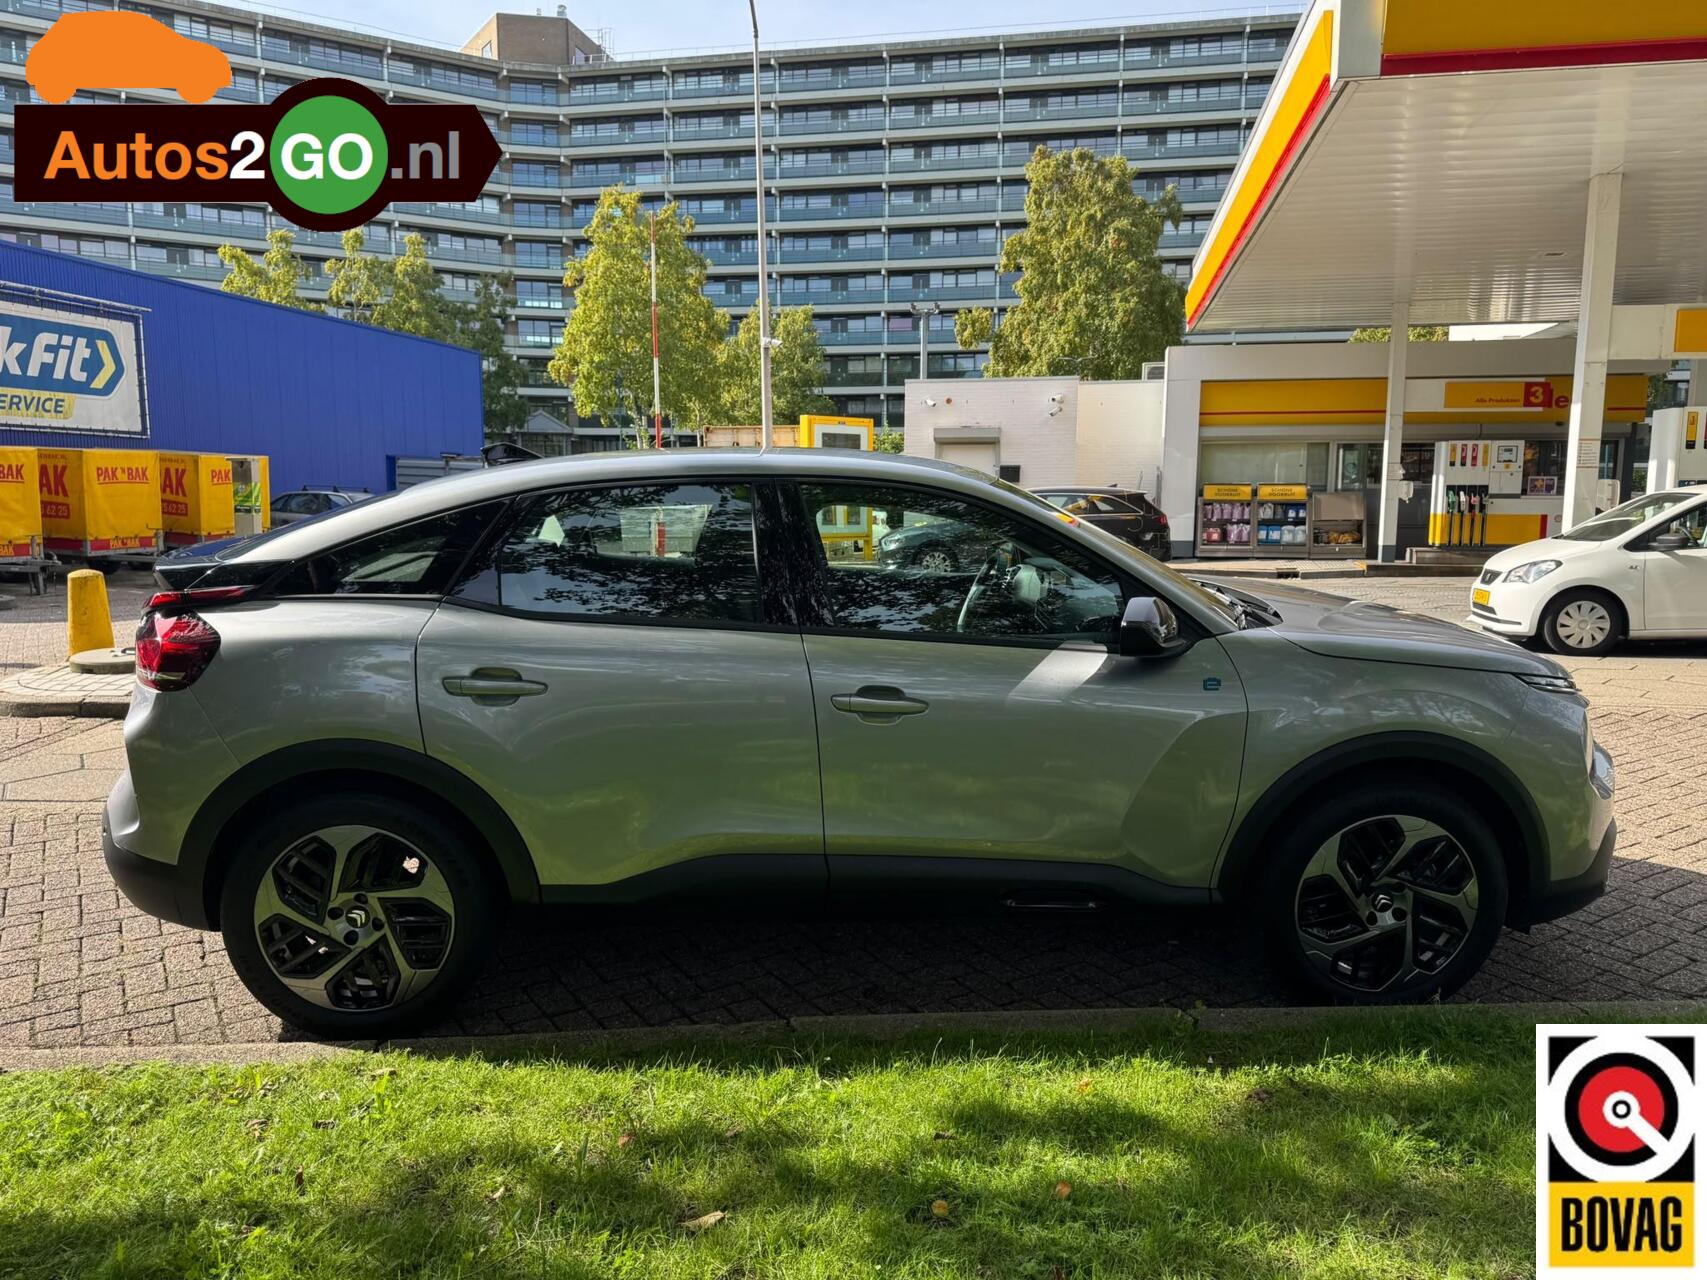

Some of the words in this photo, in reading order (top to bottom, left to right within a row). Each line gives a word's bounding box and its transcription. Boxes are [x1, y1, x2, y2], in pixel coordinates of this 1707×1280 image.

[96, 467, 119, 481] PAK
[127, 467, 149, 481] BAK
[211, 469, 232, 482] PAK
